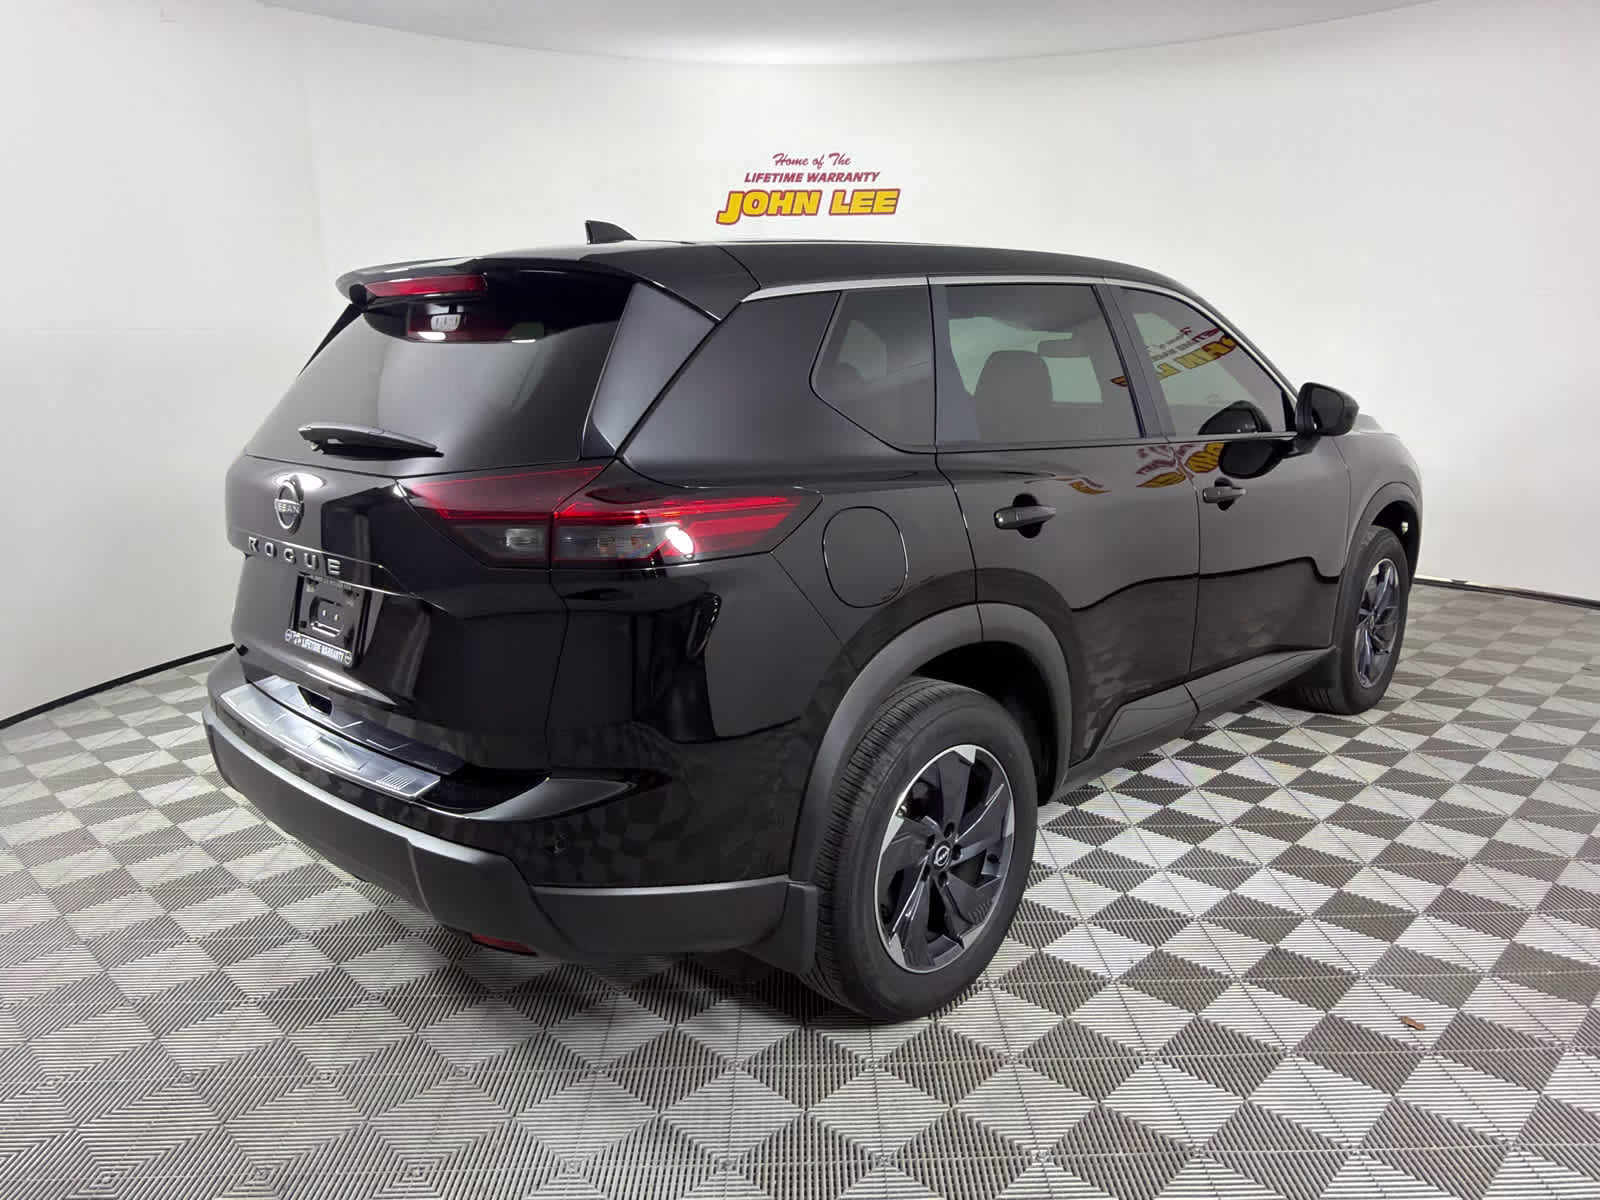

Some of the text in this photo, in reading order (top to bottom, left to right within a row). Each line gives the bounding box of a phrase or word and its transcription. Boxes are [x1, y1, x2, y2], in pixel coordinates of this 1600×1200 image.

[772, 152, 852, 169] Home of The
[744, 171, 881, 183] LIFETIME WARRANTY
[716, 188, 901, 226] JOHN LEE
[247, 535, 342, 576] ROGUE
